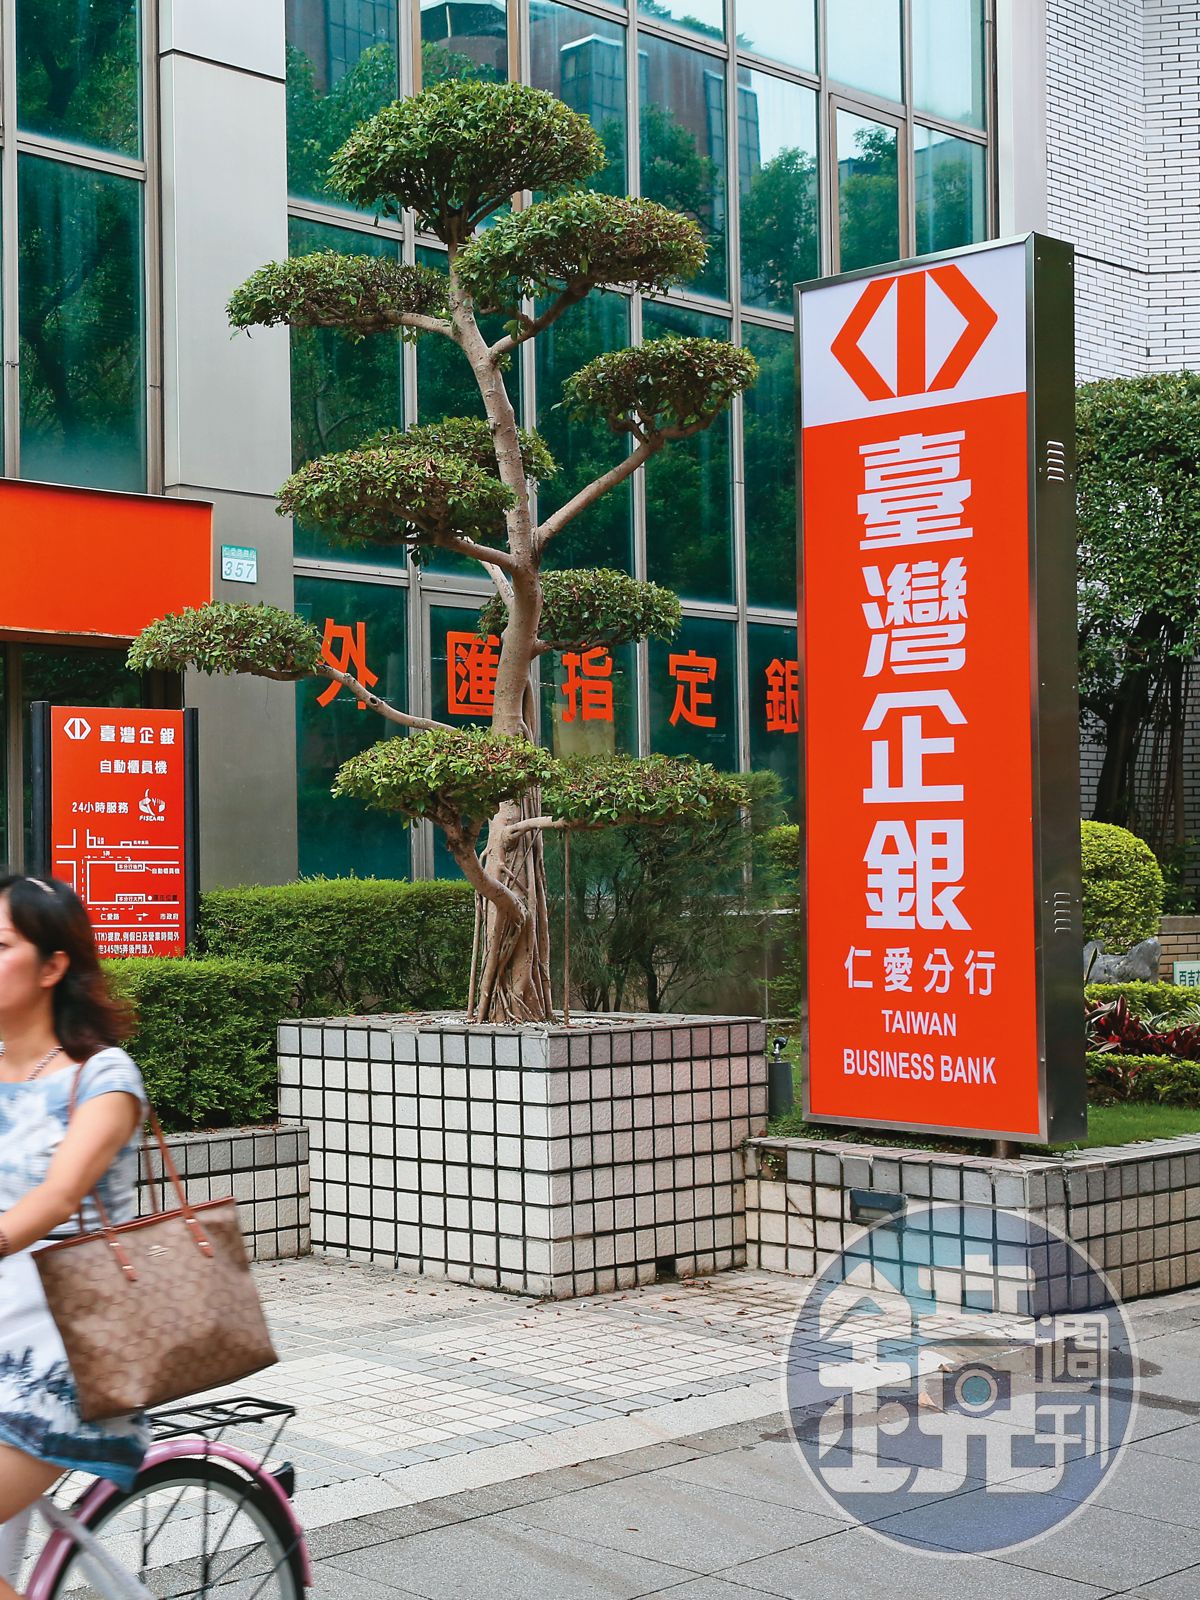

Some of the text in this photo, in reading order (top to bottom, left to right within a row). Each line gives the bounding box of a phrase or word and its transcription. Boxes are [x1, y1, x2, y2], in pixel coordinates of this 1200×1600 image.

[224, 561, 255, 578] 357
[856, 429, 974, 932] 臺灣企銀
[100, 724, 175, 745] 臺灣企銀
[100, 760, 168, 775] 自動櫃員機
[72, 801, 129, 814] 24小時服務
[844, 945, 997, 997] 仁愛分行
[881, 1010, 957, 1037] TAIWAN
[843, 1048, 997, 1085] BUSINESS BANK
